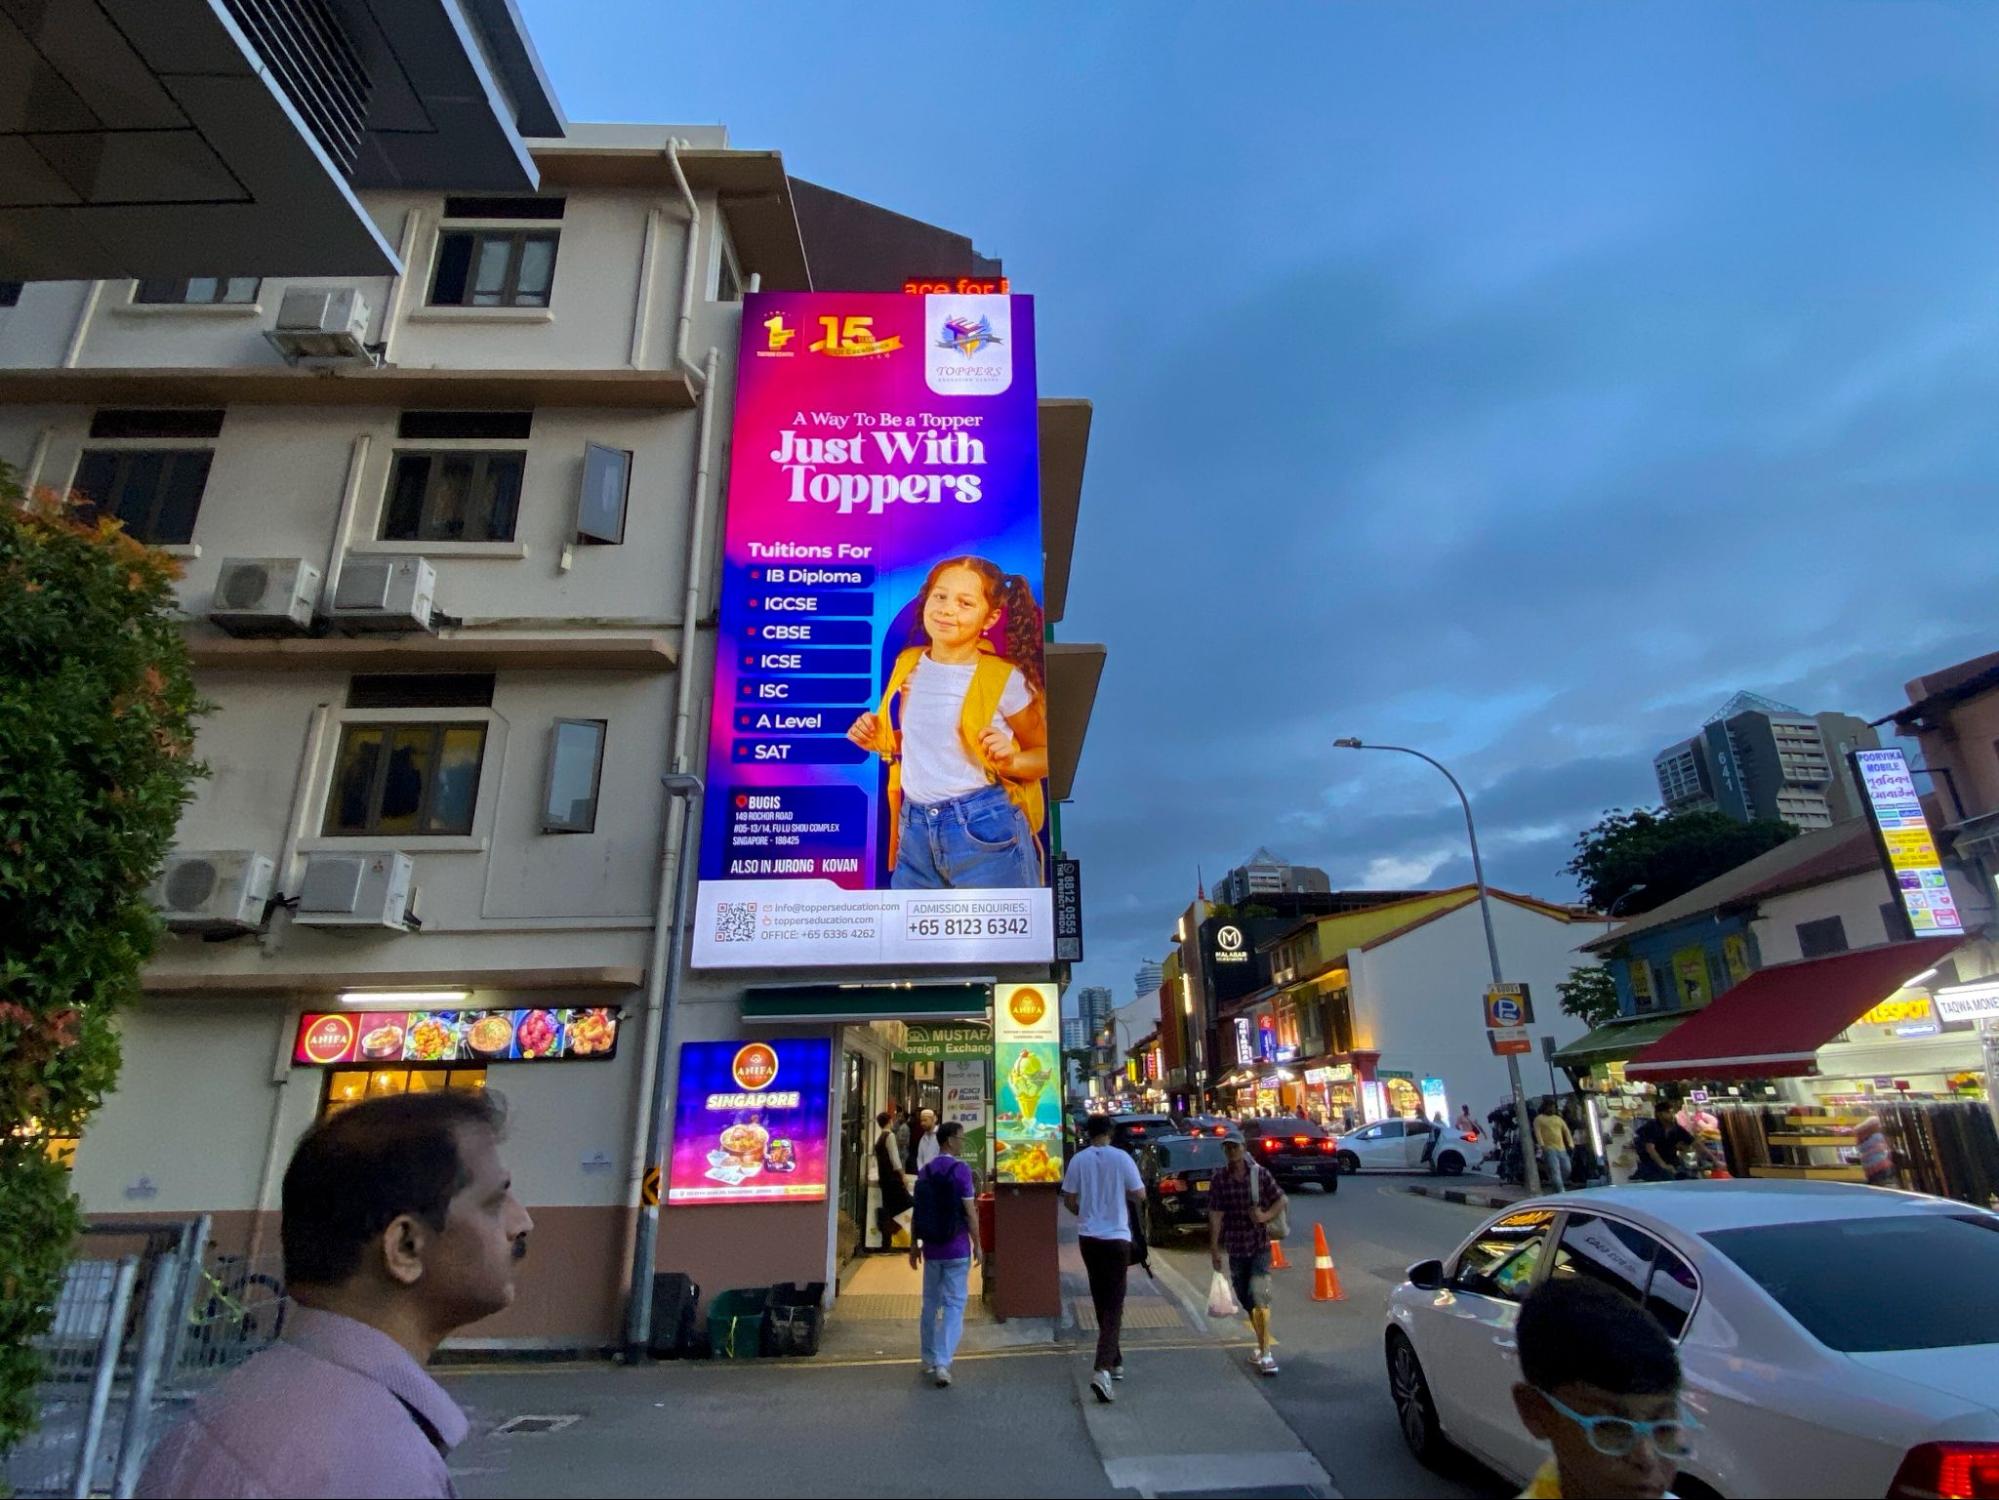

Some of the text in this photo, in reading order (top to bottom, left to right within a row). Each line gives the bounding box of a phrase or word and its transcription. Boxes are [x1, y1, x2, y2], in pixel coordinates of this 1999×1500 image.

[819, 316, 873, 350] 15
[936, 366, 1002, 377] TOPPERS
[793, 412, 983, 430] A Way To Be a Topper
[770, 430, 987, 465] Just With
[782, 465, 984, 514] Toppers
[748, 542, 872, 559] Tuitions For
[766, 570, 862, 586] IB Diploma
[765, 597, 818, 611] IGCSE
[762, 625, 811, 640] CBSE
[761, 654, 802, 668] ICSE
[759, 684, 789, 699] ISC
[756, 714, 822, 728] A Level
[754, 744, 791, 760] SAT
[1856, 752, 1902, 761] POORVIKA
[1866, 763, 1900, 772] MOBILE
[748, 796, 781, 809] BUGIS
[736, 812, 793, 820] 149 ROCHOR ROAD
[809, 823, 840, 832] COMPLEX
[732, 836, 768, 845] SINGAPORE
[731, 859, 858, 874] ALSO IN JURONG KOVAN
[1056, 864, 1066, 934] THE PERFECT MEDIA
[1064, 876, 1077, 934] 8812 0555
[913, 902, 1028, 914] ADMISSION ENQUIRIES:
[774, 915, 874, 926] topperseducation.com
[909, 918, 1028, 936] +65 8123 6342
[801, 930, 820, 939] +65
[823, 930, 847, 939] 6336
[850, 929, 875, 938] 4262
[1940, 996, 1999, 1014] TAQWA MONE
[904, 1043, 992, 1055] oreign Exchang
[708, 1093, 799, 1109] SINGAPORE
